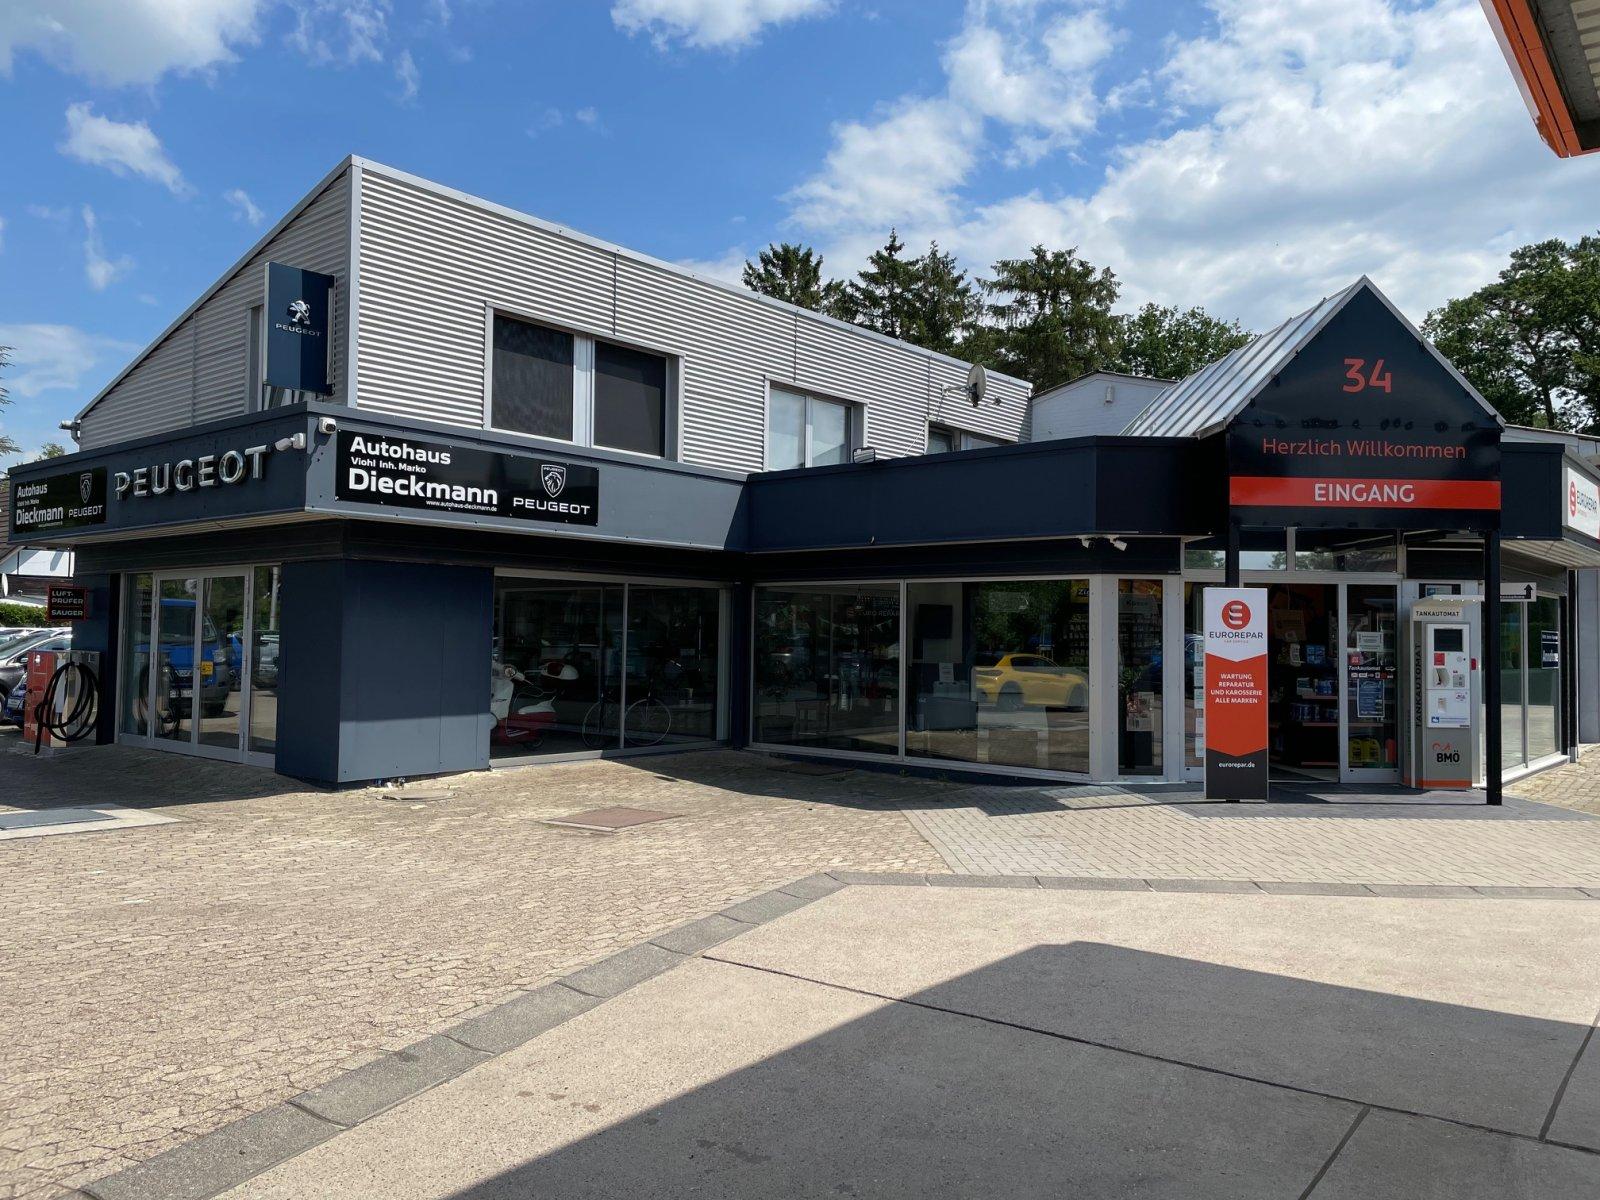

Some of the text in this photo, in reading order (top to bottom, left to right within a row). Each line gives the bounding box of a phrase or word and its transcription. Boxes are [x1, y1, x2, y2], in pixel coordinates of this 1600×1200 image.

[275, 323, 321, 337] PEUGEOT
[1343, 358, 1392, 393] 34
[350, 436, 451, 465] Autohaus
[1262, 438, 1466, 459] Herzlich Willkommen
[114, 445, 267, 499] PEUGEOT
[351, 456, 427, 474] Viohl Inh. Marko
[17, 483, 48, 498] Autohaus
[348, 467, 498, 505] Dieckmann
[1314, 483, 1415, 503] EINGANG
[68, 504, 103, 518] PEUGEOT
[513, 497, 591, 515] PEUGEOT
[15, 506, 64, 525] Dieckmann
[1209, 631, 1264, 639] EUROREPAR
[1436, 749, 1460, 763] BMÖ
